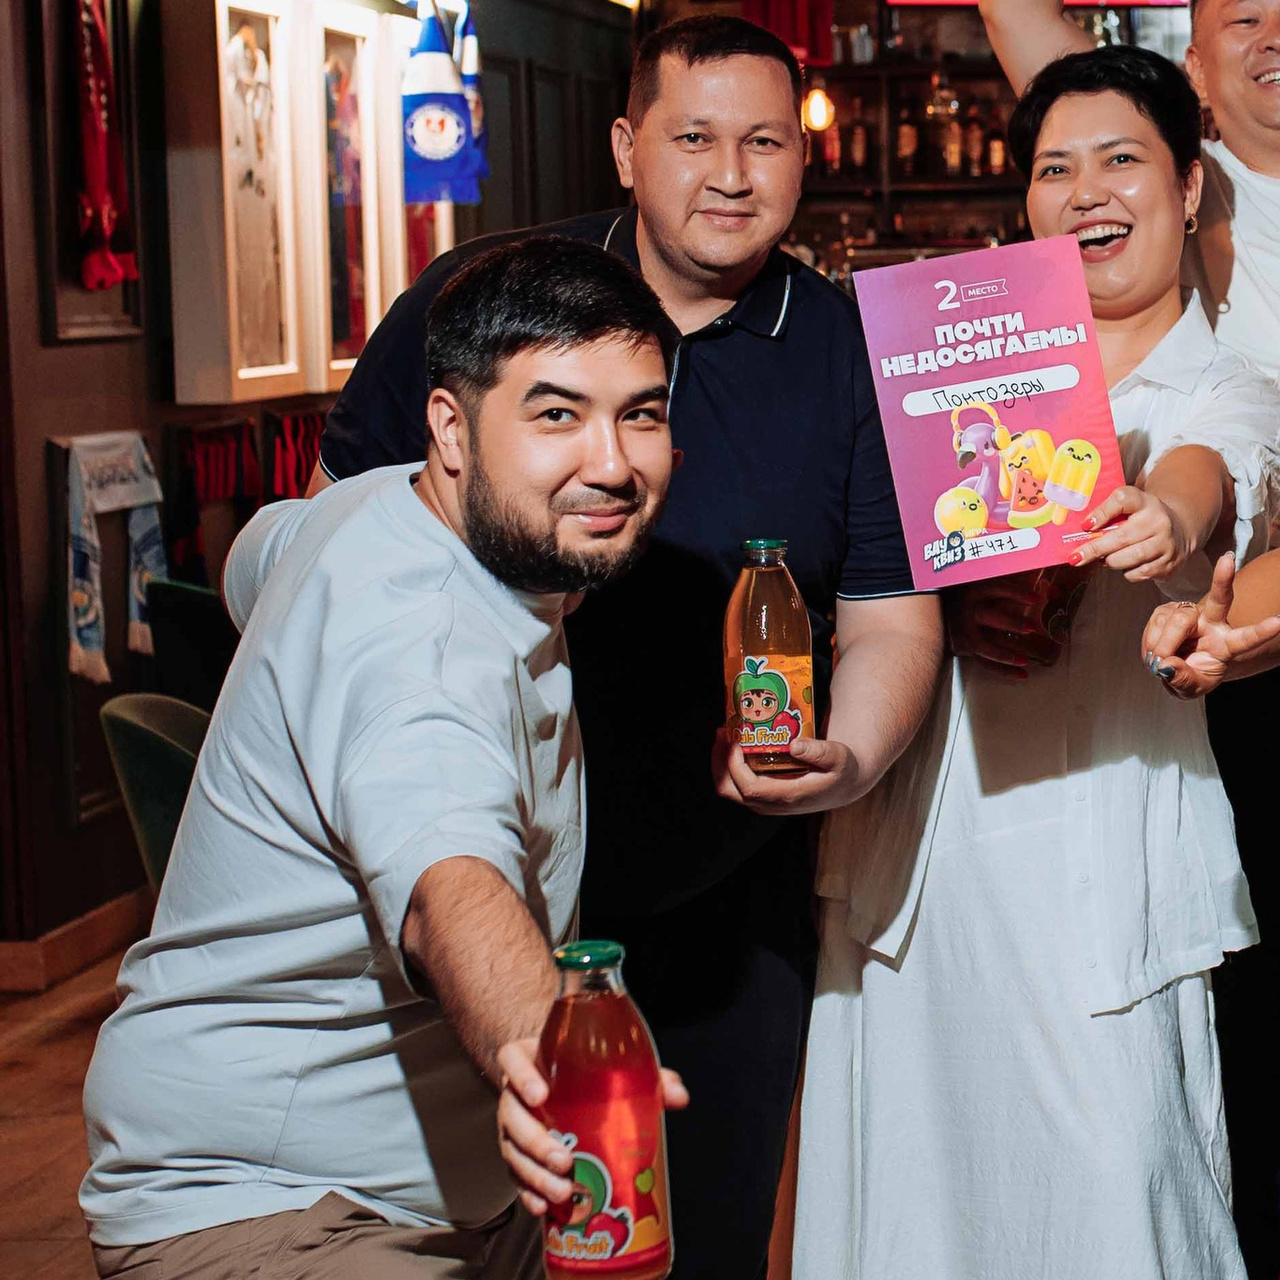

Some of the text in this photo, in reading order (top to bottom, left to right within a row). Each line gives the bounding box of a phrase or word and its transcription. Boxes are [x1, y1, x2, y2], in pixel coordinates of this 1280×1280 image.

[934, 280, 999, 311] 2 МЕСТО
[934, 312, 1025, 346] ПОЧТИ
[880, 323, 1087, 378] НЕДОСЯГАЕМЫ
[932, 376, 1045, 410] Понтозеры
[933, 548, 963, 571] КВИЗ
[757, 728, 789, 743] Fruit
